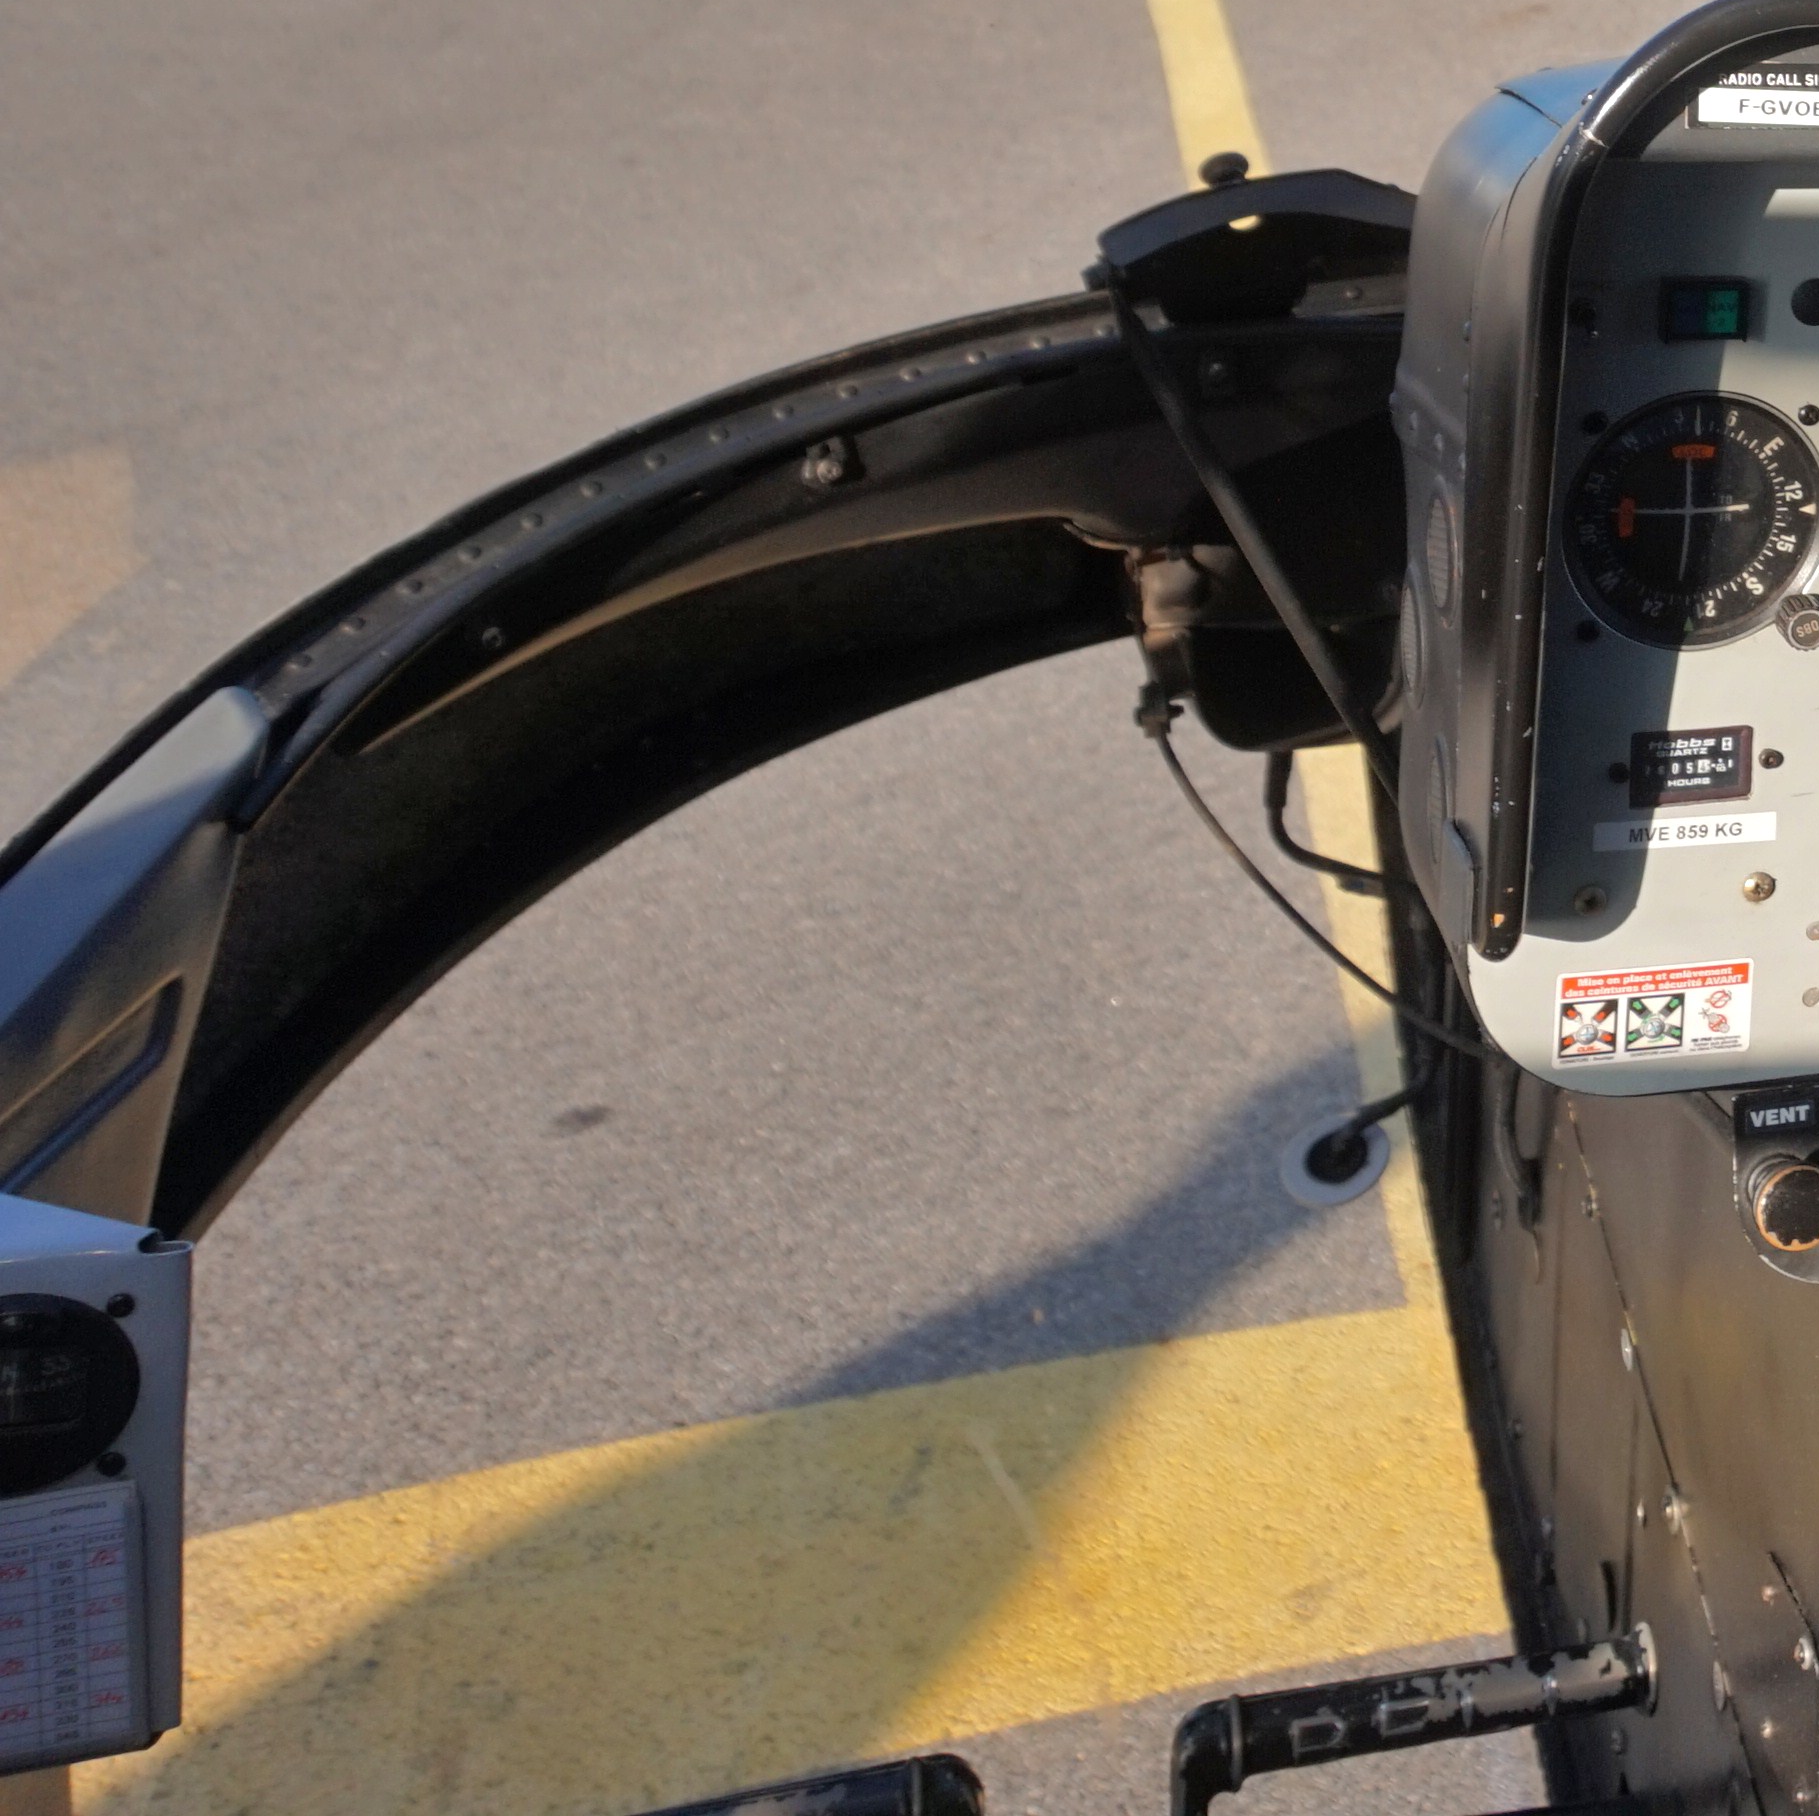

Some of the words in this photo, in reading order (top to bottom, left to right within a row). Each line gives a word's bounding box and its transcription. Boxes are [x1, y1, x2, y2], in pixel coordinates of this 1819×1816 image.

[1766, 74, 1802, 86] CALL
[1629, 826, 1670, 843] MVE
[1676, 824, 1709, 839] 859
[1715, 822, 1743, 838] KG
[1565, 988, 1584, 998] des
[1587, 984, 1639, 996] ceintures
[1642, 982, 1655, 991] de
[1658, 979, 1702, 991] sécurité
[1705, 974, 1743, 985] AVANT
[1577, 978, 1602, 987] Mise
[1606, 977, 1621, 985] en
[1623, 973, 1652, 985] place
[1669, 967, 1732, 980] enlèvement
[1750, 1105, 1810, 1128] VENT
